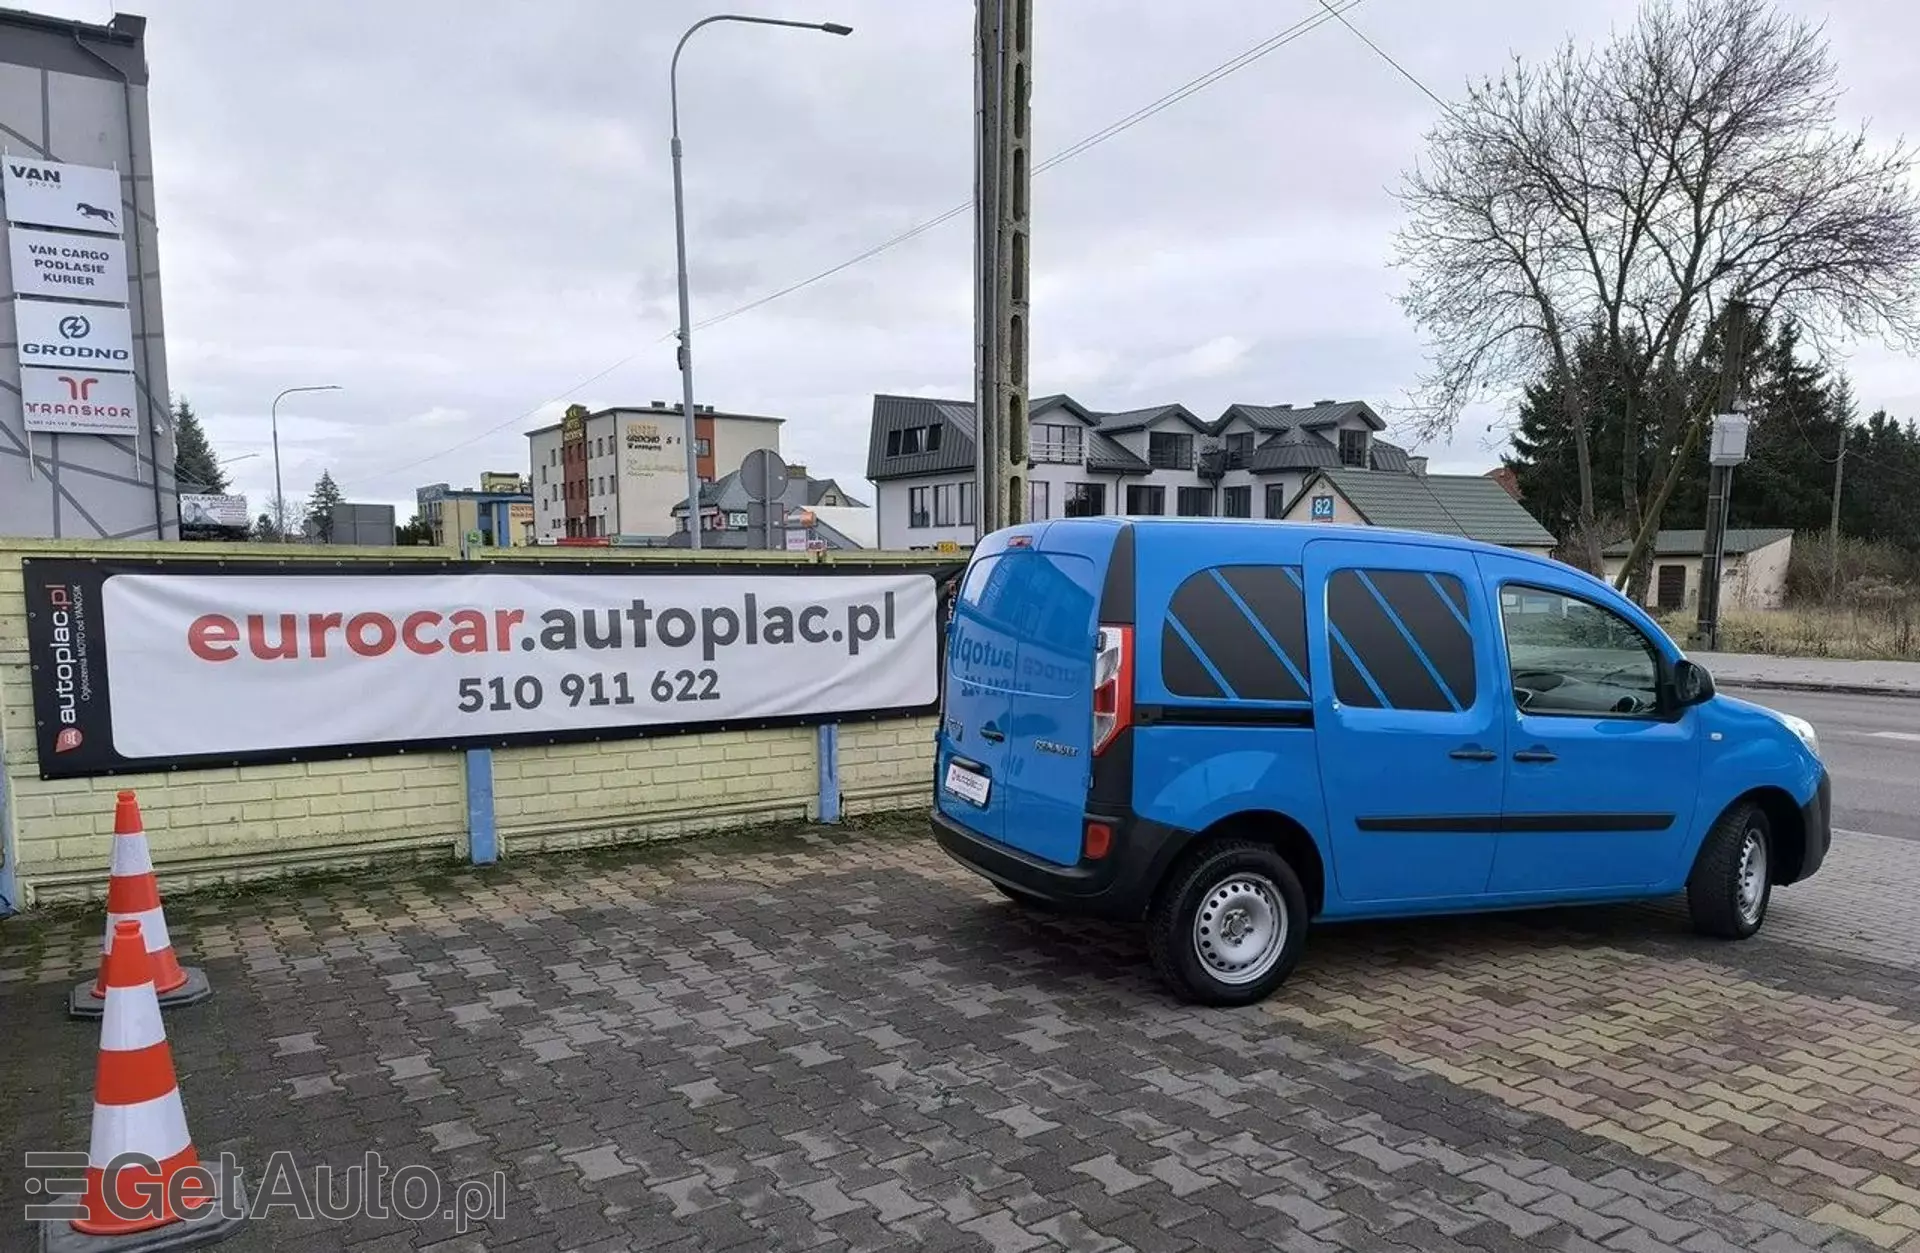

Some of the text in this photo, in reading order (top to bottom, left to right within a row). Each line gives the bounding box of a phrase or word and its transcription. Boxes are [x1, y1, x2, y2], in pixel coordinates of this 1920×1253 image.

[10, 165, 61, 183] VAN
[29, 244, 110, 261] VAN CARGO
[34, 259, 105, 274] PODLASIE
[43, 273, 95, 286] KURIER
[23, 343, 128, 360] GRODNO
[25, 402, 132, 418] TRANSKOR
[1315, 498, 1331, 515] 82
[72, 584, 84, 619] YANOSIK
[76, 621, 86, 631] od
[187, 592, 896, 662] eurocar.autoplac.pl
[76, 632, 87, 657] MOTO
[45, 584, 77, 724] autoplac.pl
[459, 668, 720, 713] 510 911 622
